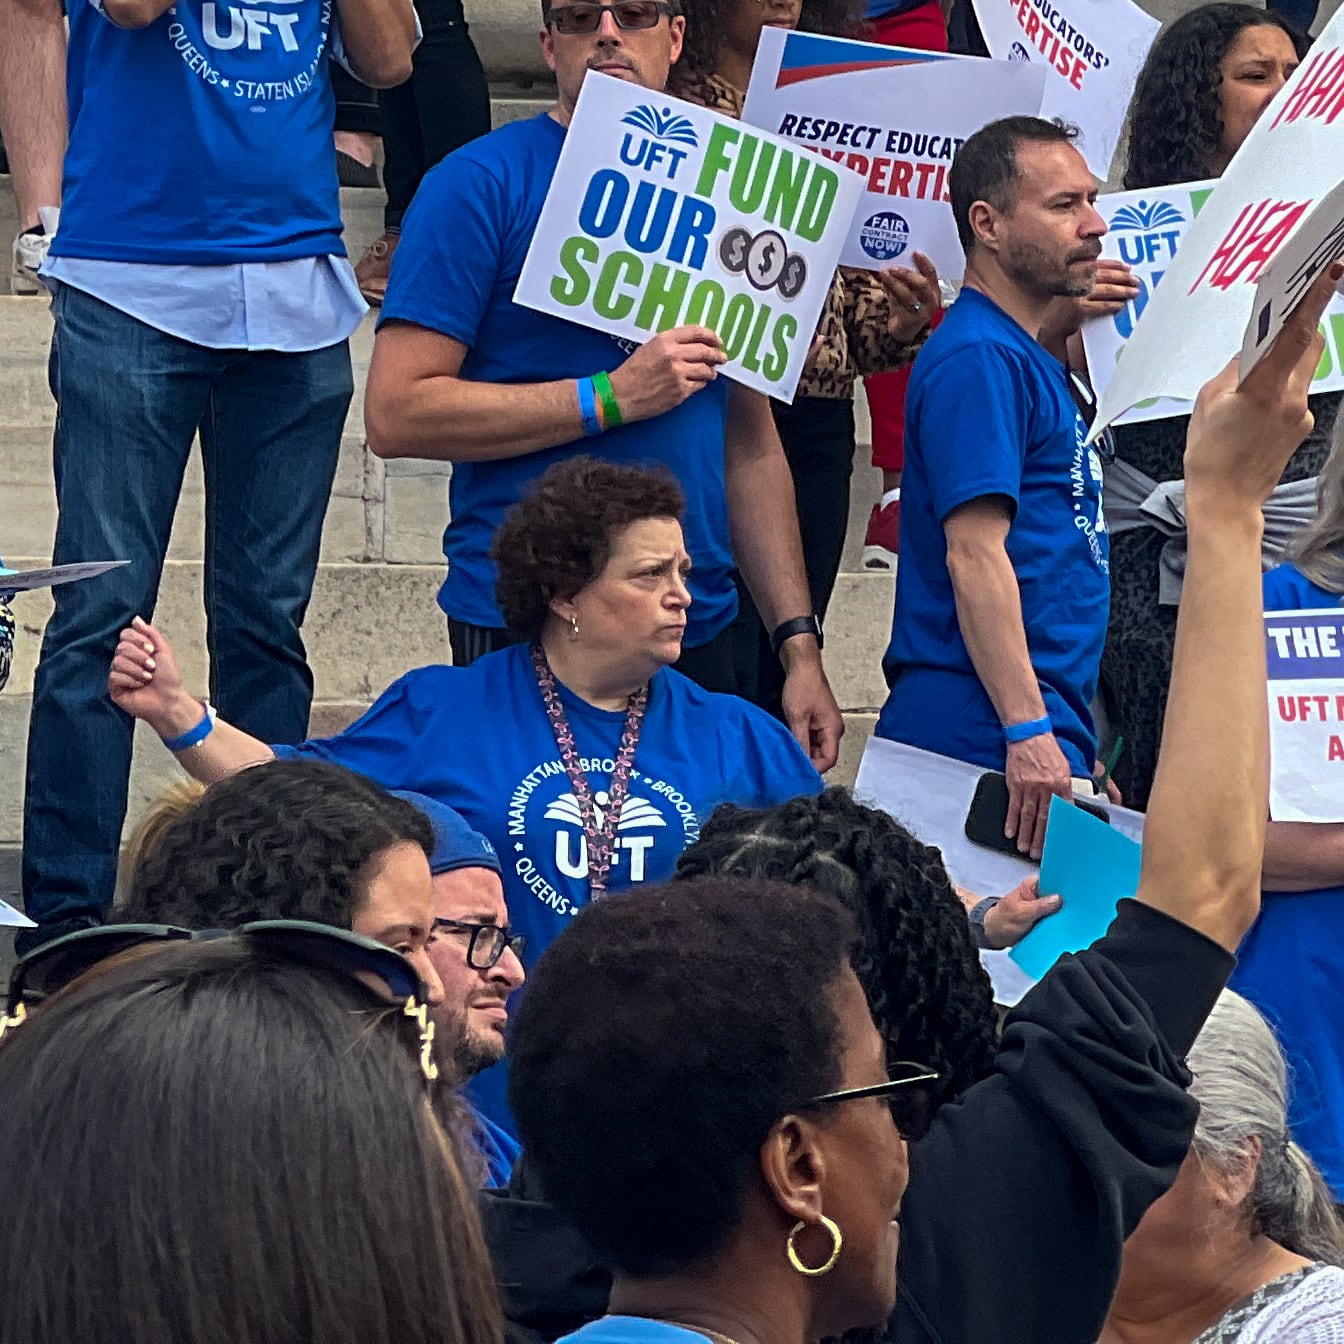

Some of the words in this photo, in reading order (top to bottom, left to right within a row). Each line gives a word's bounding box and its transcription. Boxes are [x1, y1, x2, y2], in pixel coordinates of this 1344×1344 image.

[202, 2, 299, 52] UFT
[168, 22, 220, 85] QUEENS
[234, 80, 295, 101] STATEN
[778, 113, 882, 150] RESPECT
[885, 130, 964, 160] EDUCAT
[620, 133, 688, 180] UFT
[695, 121, 840, 243] FUND
[578, 168, 717, 271] OUR
[862, 228, 909, 242] CONTRACT
[871, 217, 905, 232] FAIR
[863, 237, 903, 253] NOW!
[1118, 230, 1180, 266] UFT
[1188, 198, 1314, 297] HEA
[549, 235, 799, 383] SCHOOLS
[1267, 626, 1340, 659] THE
[1277, 695, 1329, 722] UFT
[508, 760, 567, 836] MANHATTAN
[579, 758, 640, 779] BROX
[651, 780, 701, 846] BROOKLY
[515, 857, 571, 915] QUEENS
